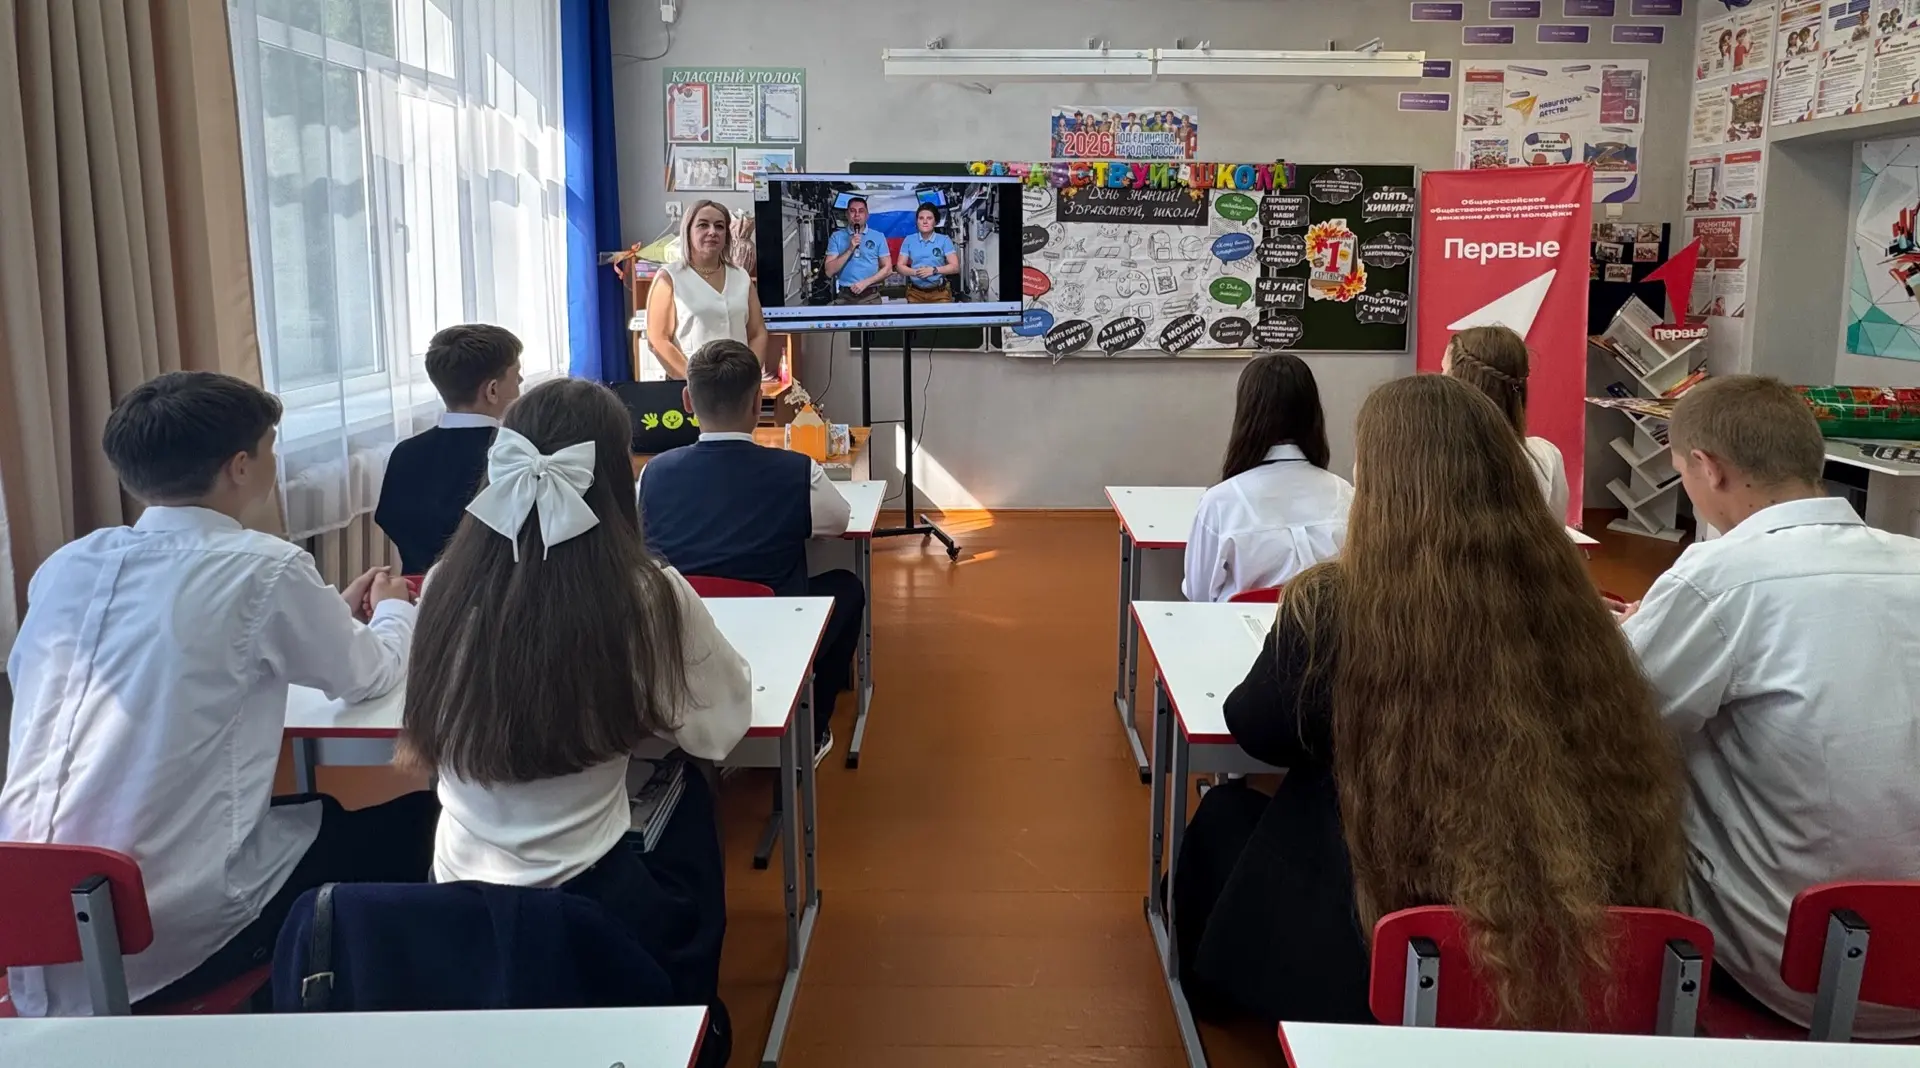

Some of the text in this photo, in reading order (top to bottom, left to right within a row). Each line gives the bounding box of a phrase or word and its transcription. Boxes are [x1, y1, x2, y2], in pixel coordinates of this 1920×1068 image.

[672, 69, 801, 84] КЛАССНЫЙ УГОЛОК
[1539, 95, 1582, 110] НАВИГАТОРЫ
[1539, 106, 1569, 118] ДЕТСТВА
[1115, 132, 1175, 143] ГОД ЕДИНСТВА
[1063, 132, 1112, 156] 2026
[1115, 144, 1185, 156] НАРОДОВ РОССИИ
[1189, 161, 1296, 191] ШКОЛА!
[1373, 192, 1408, 201] ОПЯТЬ
[1461, 197, 1546, 205] Общероссийское
[1365, 204, 1414, 212] ХИМИЯ?!
[1430, 202, 1580, 214] общественно-государственное
[1483, 212, 1512, 220] детей
[1521, 211, 1572, 219] молодёжи
[1269, 219, 1298, 227] СЕРДЦА!
[1325, 241, 1343, 273] 1
[1444, 238, 1560, 265] Первые
[1259, 280, 1272, 290] ЧЁ
[1281, 283, 1303, 291] НАС
[1264, 294, 1296, 304] ЩАС?!
[1370, 306, 1400, 315] УРОКА!
[1045, 322, 1090, 345] ДАЙТЕ ПАРОЛЬ
[1101, 330, 1108, 338] А
[1114, 318, 1137, 332] МЕНЯ
[1166, 315, 1201, 340] МОЖНО
[1100, 334, 1126, 349] РУЧКИ
[1126, 328, 1140, 339] НЕТ
[1168, 326, 1204, 352] ВЫЙТИ?
